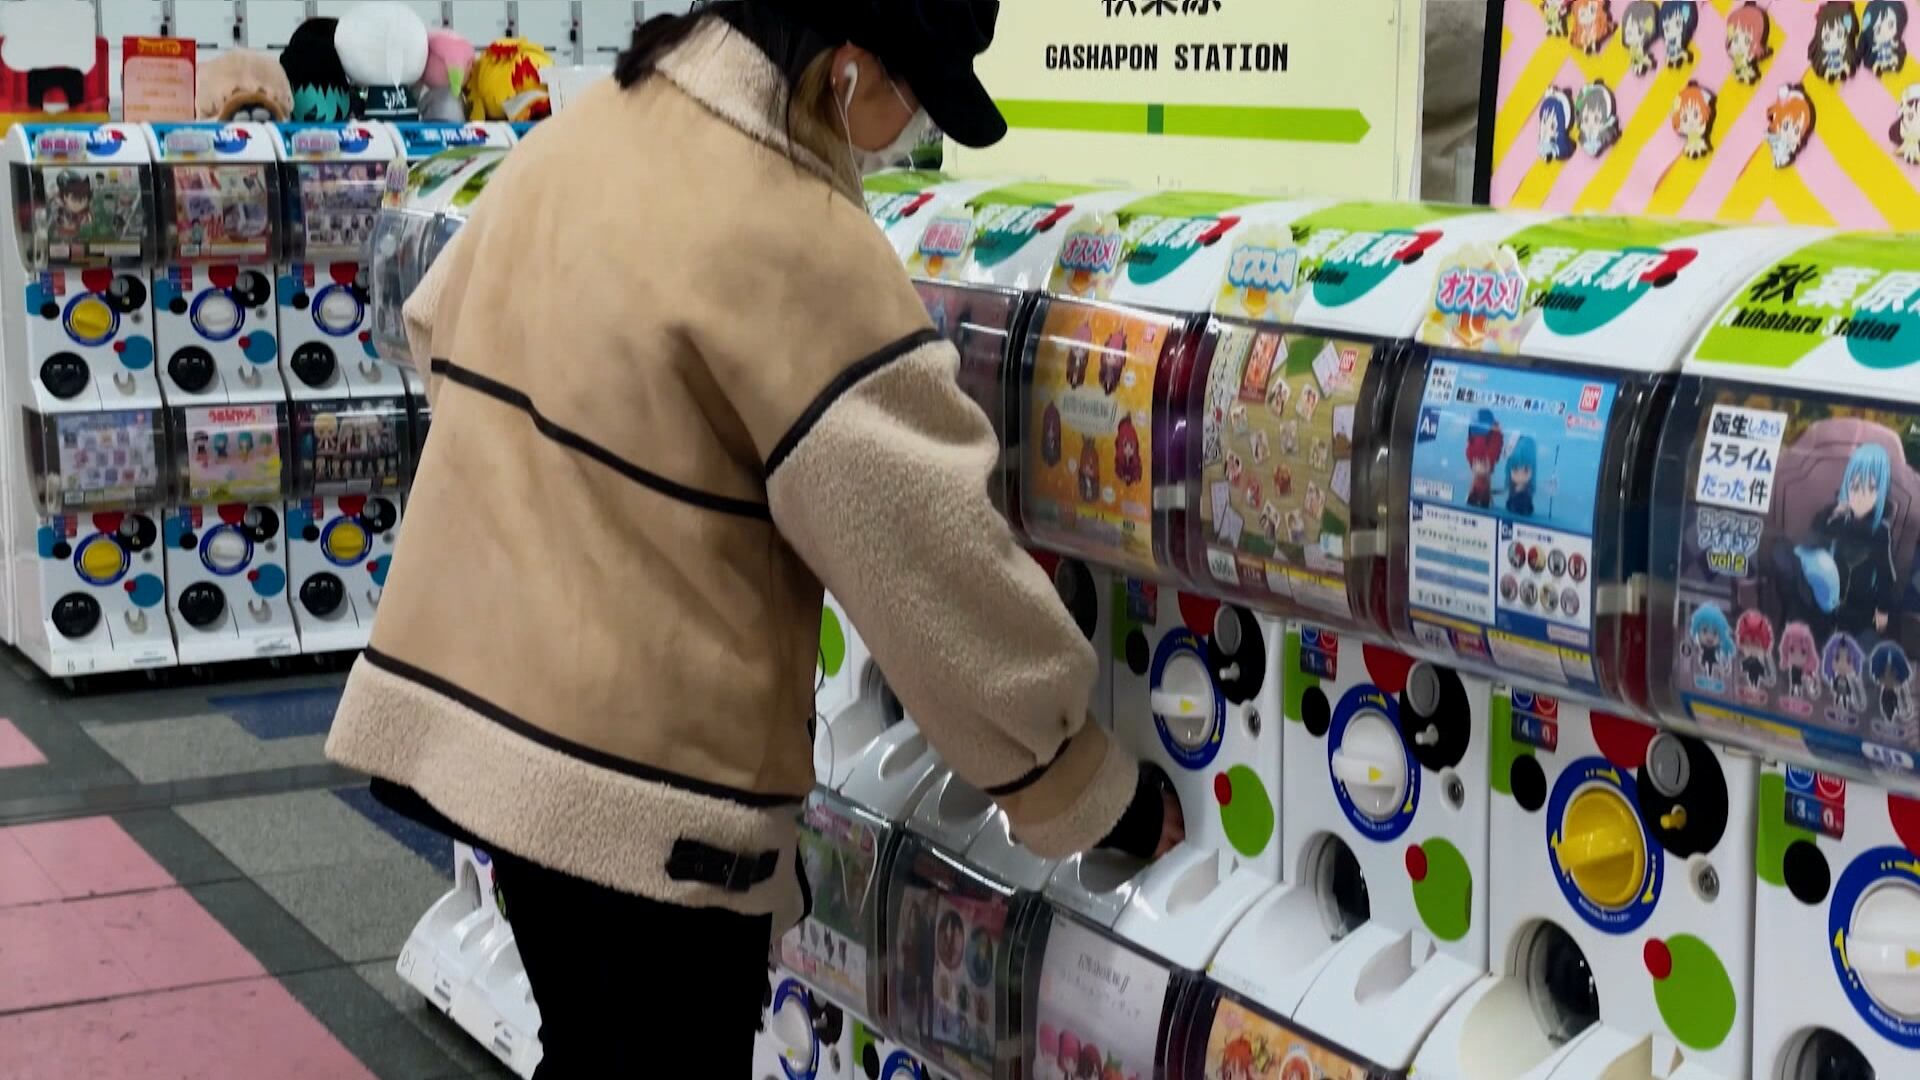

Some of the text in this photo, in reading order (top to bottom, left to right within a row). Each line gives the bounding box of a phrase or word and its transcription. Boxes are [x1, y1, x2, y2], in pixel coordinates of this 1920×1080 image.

[1045, 43, 1289, 73] GASHAPON STATION
[1438, 269, 1522, 314] オススメ!
[1749, 263, 1920, 315] 秋葉原
[1720, 305, 1902, 342] Akihabara Station
[1711, 411, 1781, 440] 転生したら
[1705, 442, 1772, 473] スライム
[1700, 474, 1768, 506] だった件
